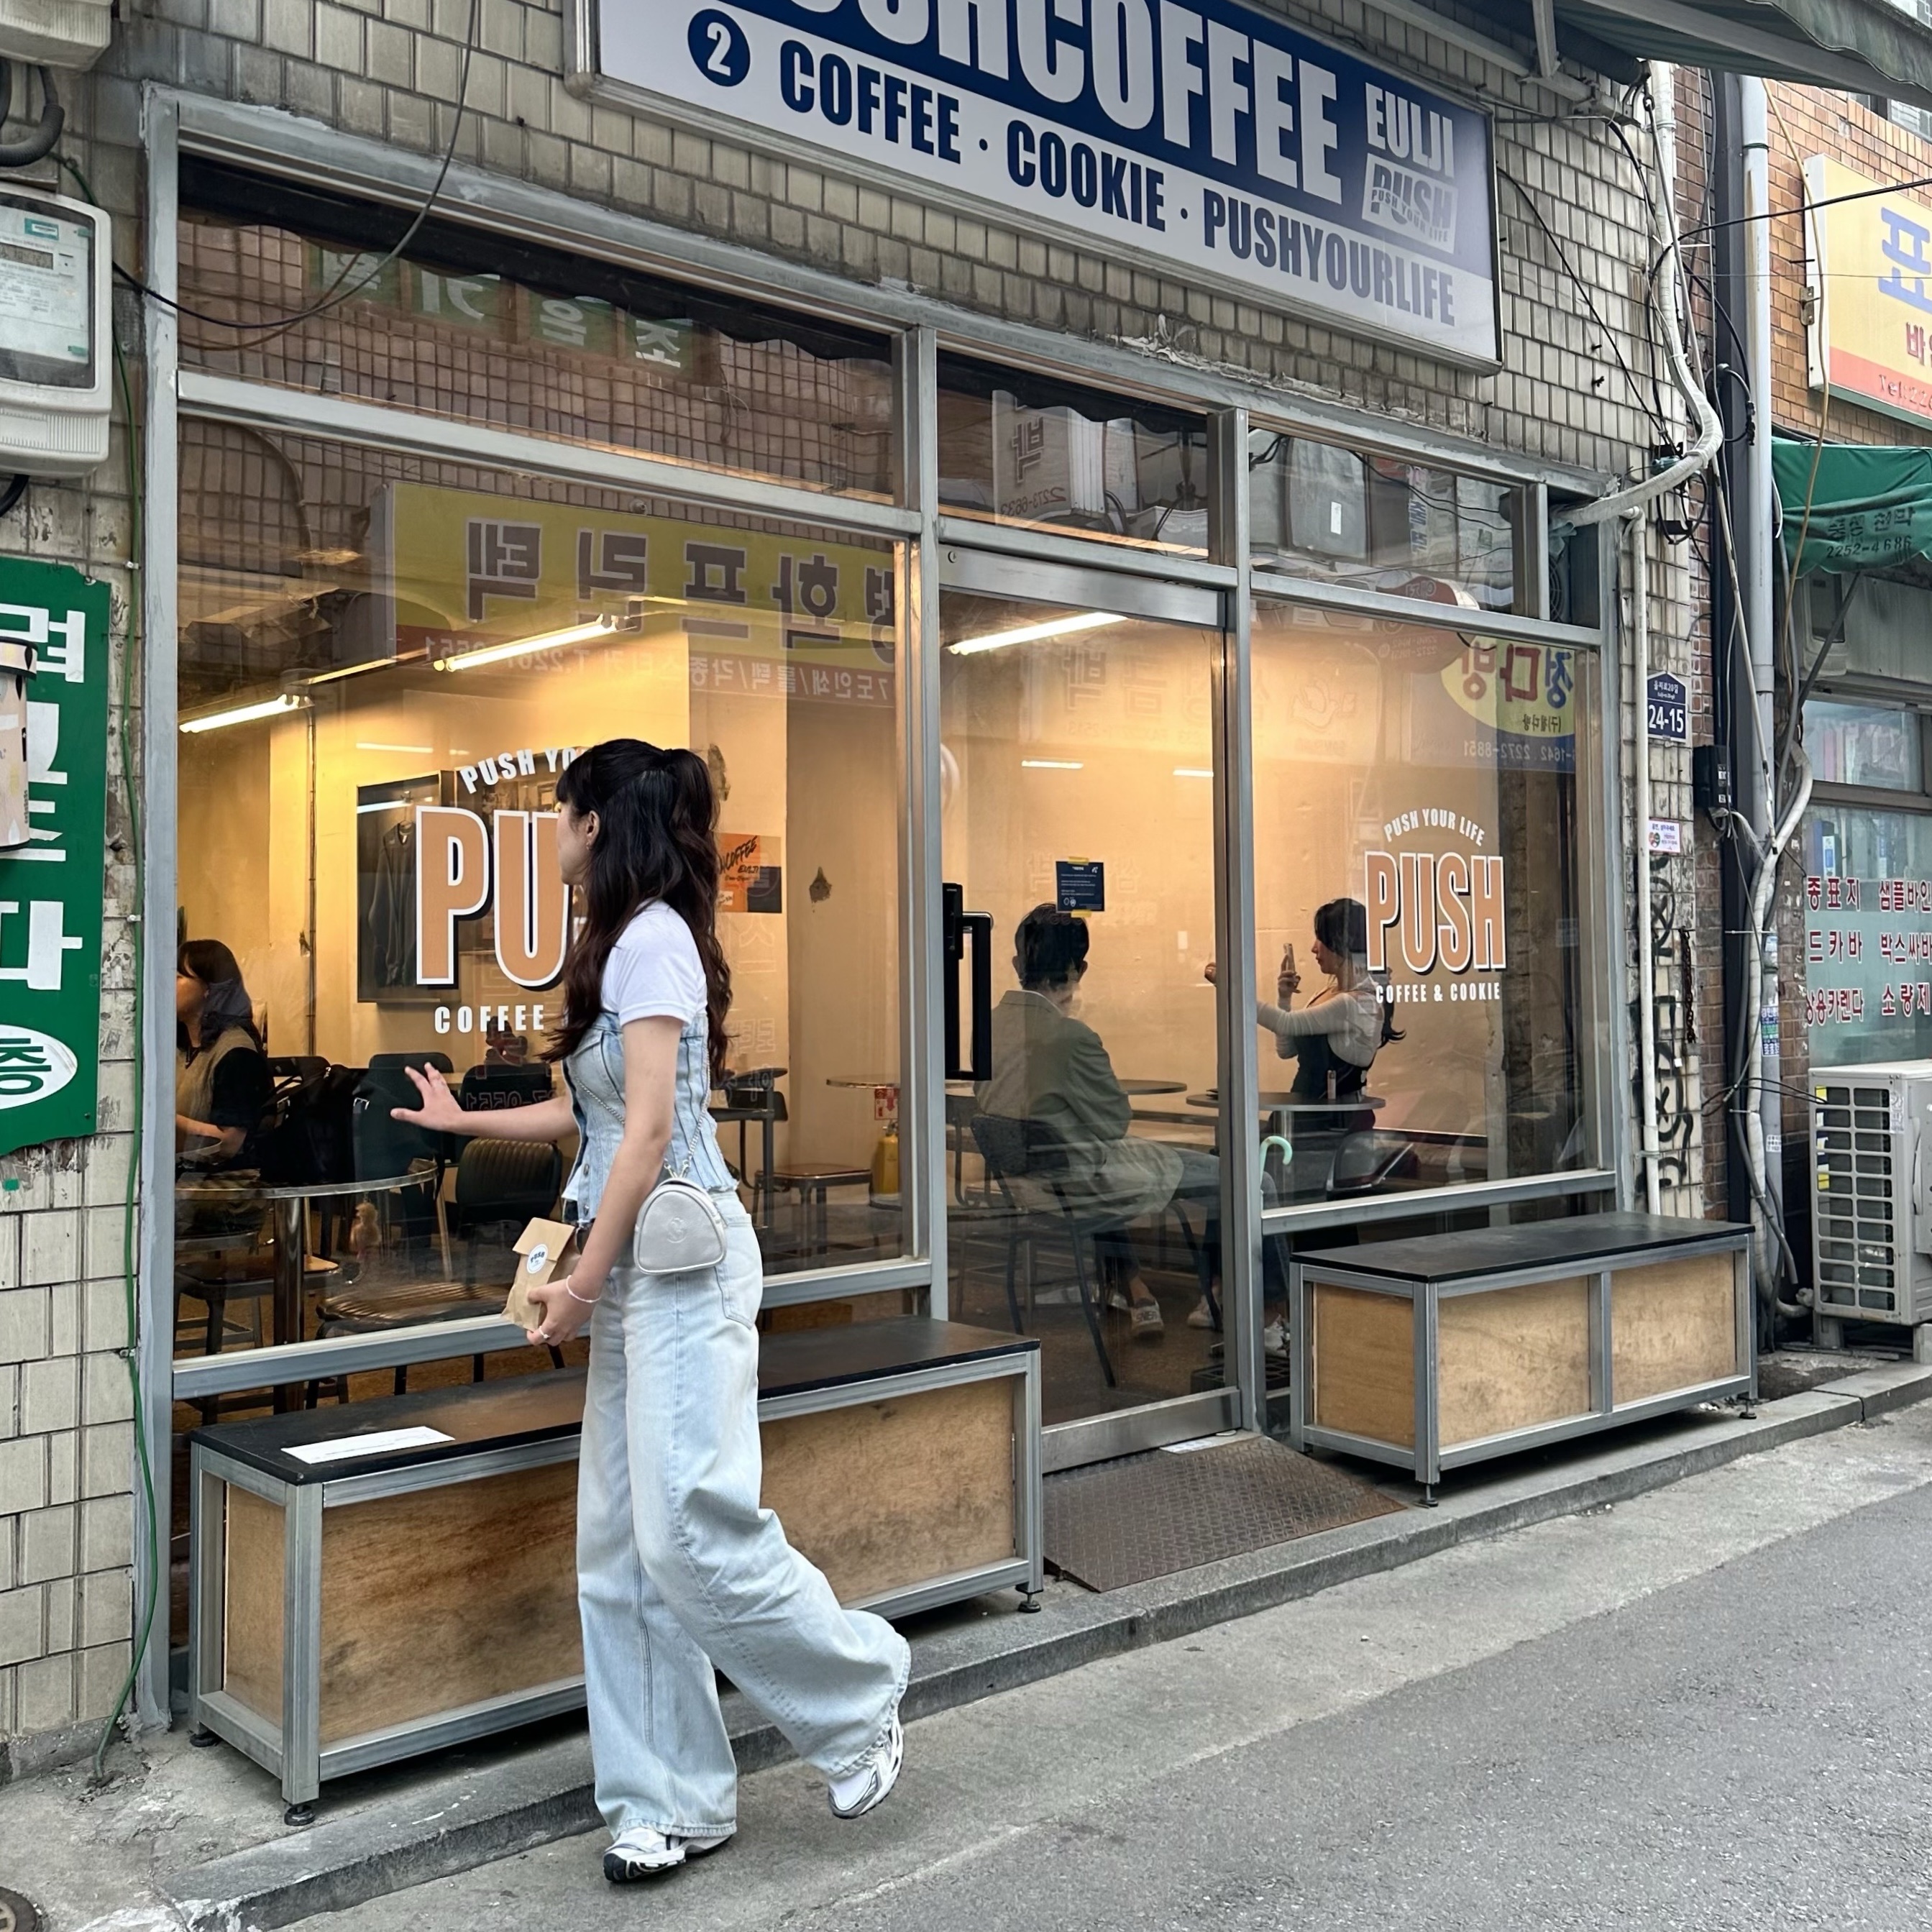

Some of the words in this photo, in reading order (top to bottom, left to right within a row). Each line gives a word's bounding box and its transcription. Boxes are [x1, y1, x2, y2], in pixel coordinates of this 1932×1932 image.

[793, 0, 1342, 205] COFFEE
[1365, 82, 1455, 179] EULJI
[707, 22, 731, 76] 2
[780, 40, 961, 164] COFFEE
[1007, 119, 1166, 232] COOKIE
[1204, 188, 1455, 327] PUSHYOURLIFE
[1371, 189, 1398, 209] PUSH
[1401, 202, 1426, 235] YOUR
[1429, 226, 1449, 242] LIFE
[1906, 322, 1932, 367] 바
[1648, 704, 1684, 733] 24-15
[459, 748, 535, 794] PUSH
[1383, 810, 1419, 843] PUSH
[1421, 807, 1456, 830] YOUR
[1459, 816, 1485, 846] LIFE
[416, 805, 573, 989] PU
[1365, 851, 1506, 974] PUSH
[1375, 984, 1427, 1004] COFFEE
[1433, 983, 1443, 1002] &
[1450, 982, 1501, 1002] COOKIE
[434, 1004, 544, 1035] COFFEE
